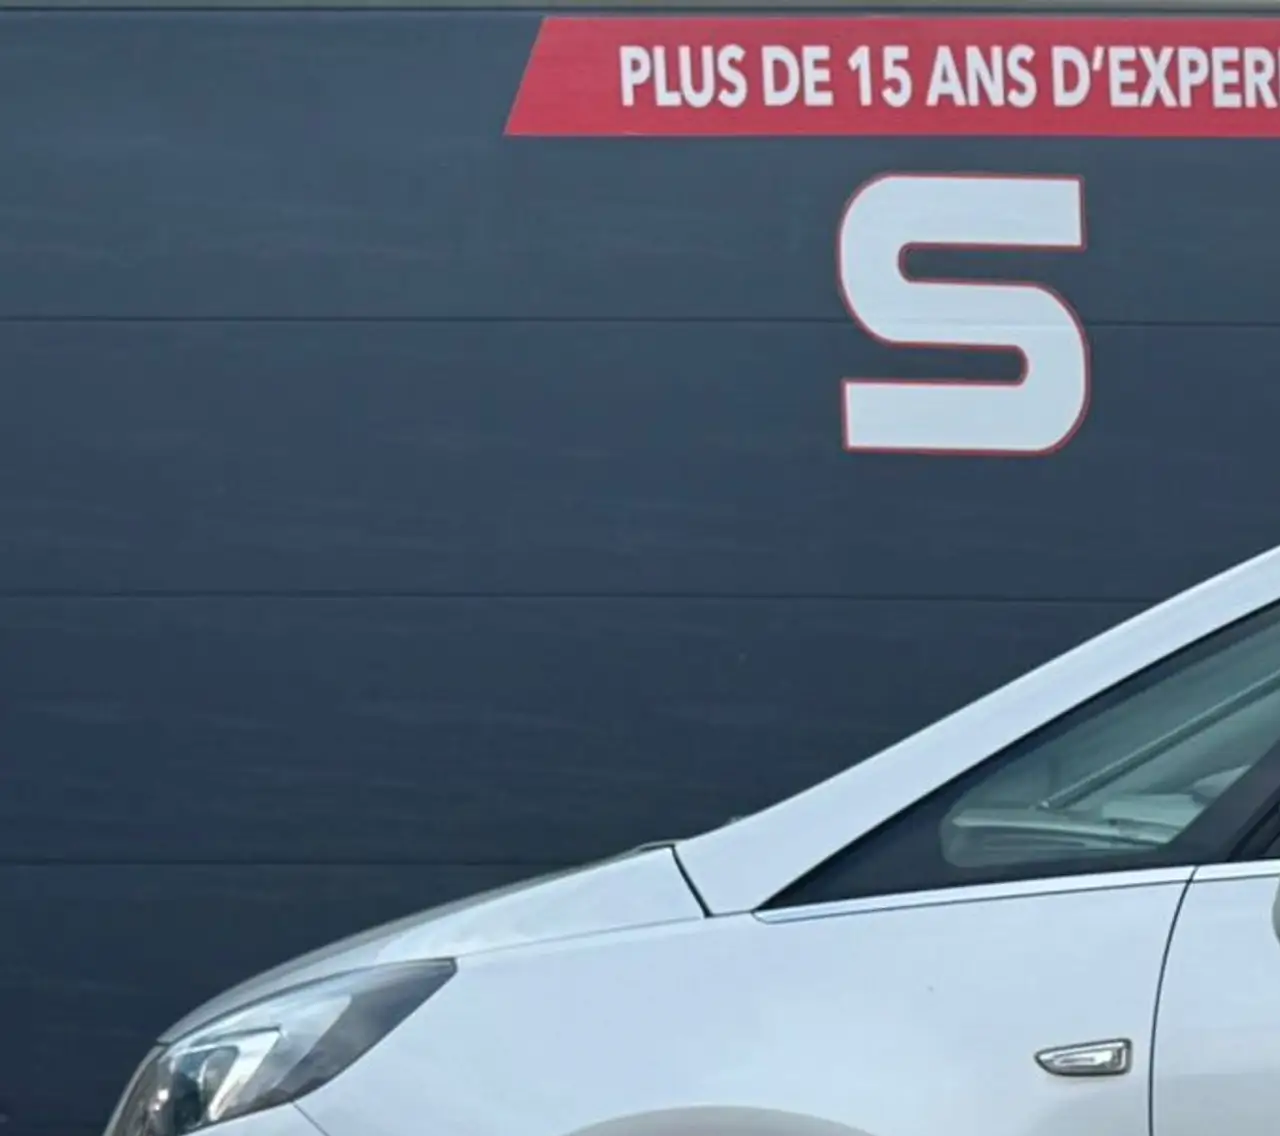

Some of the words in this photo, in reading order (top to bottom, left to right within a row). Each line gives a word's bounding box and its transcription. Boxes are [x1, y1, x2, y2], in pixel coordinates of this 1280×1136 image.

[619, 44, 748, 108] PLUS
[761, 45, 834, 107] DE
[848, 45, 913, 108] 15
[926, 44, 1038, 108] ANS
